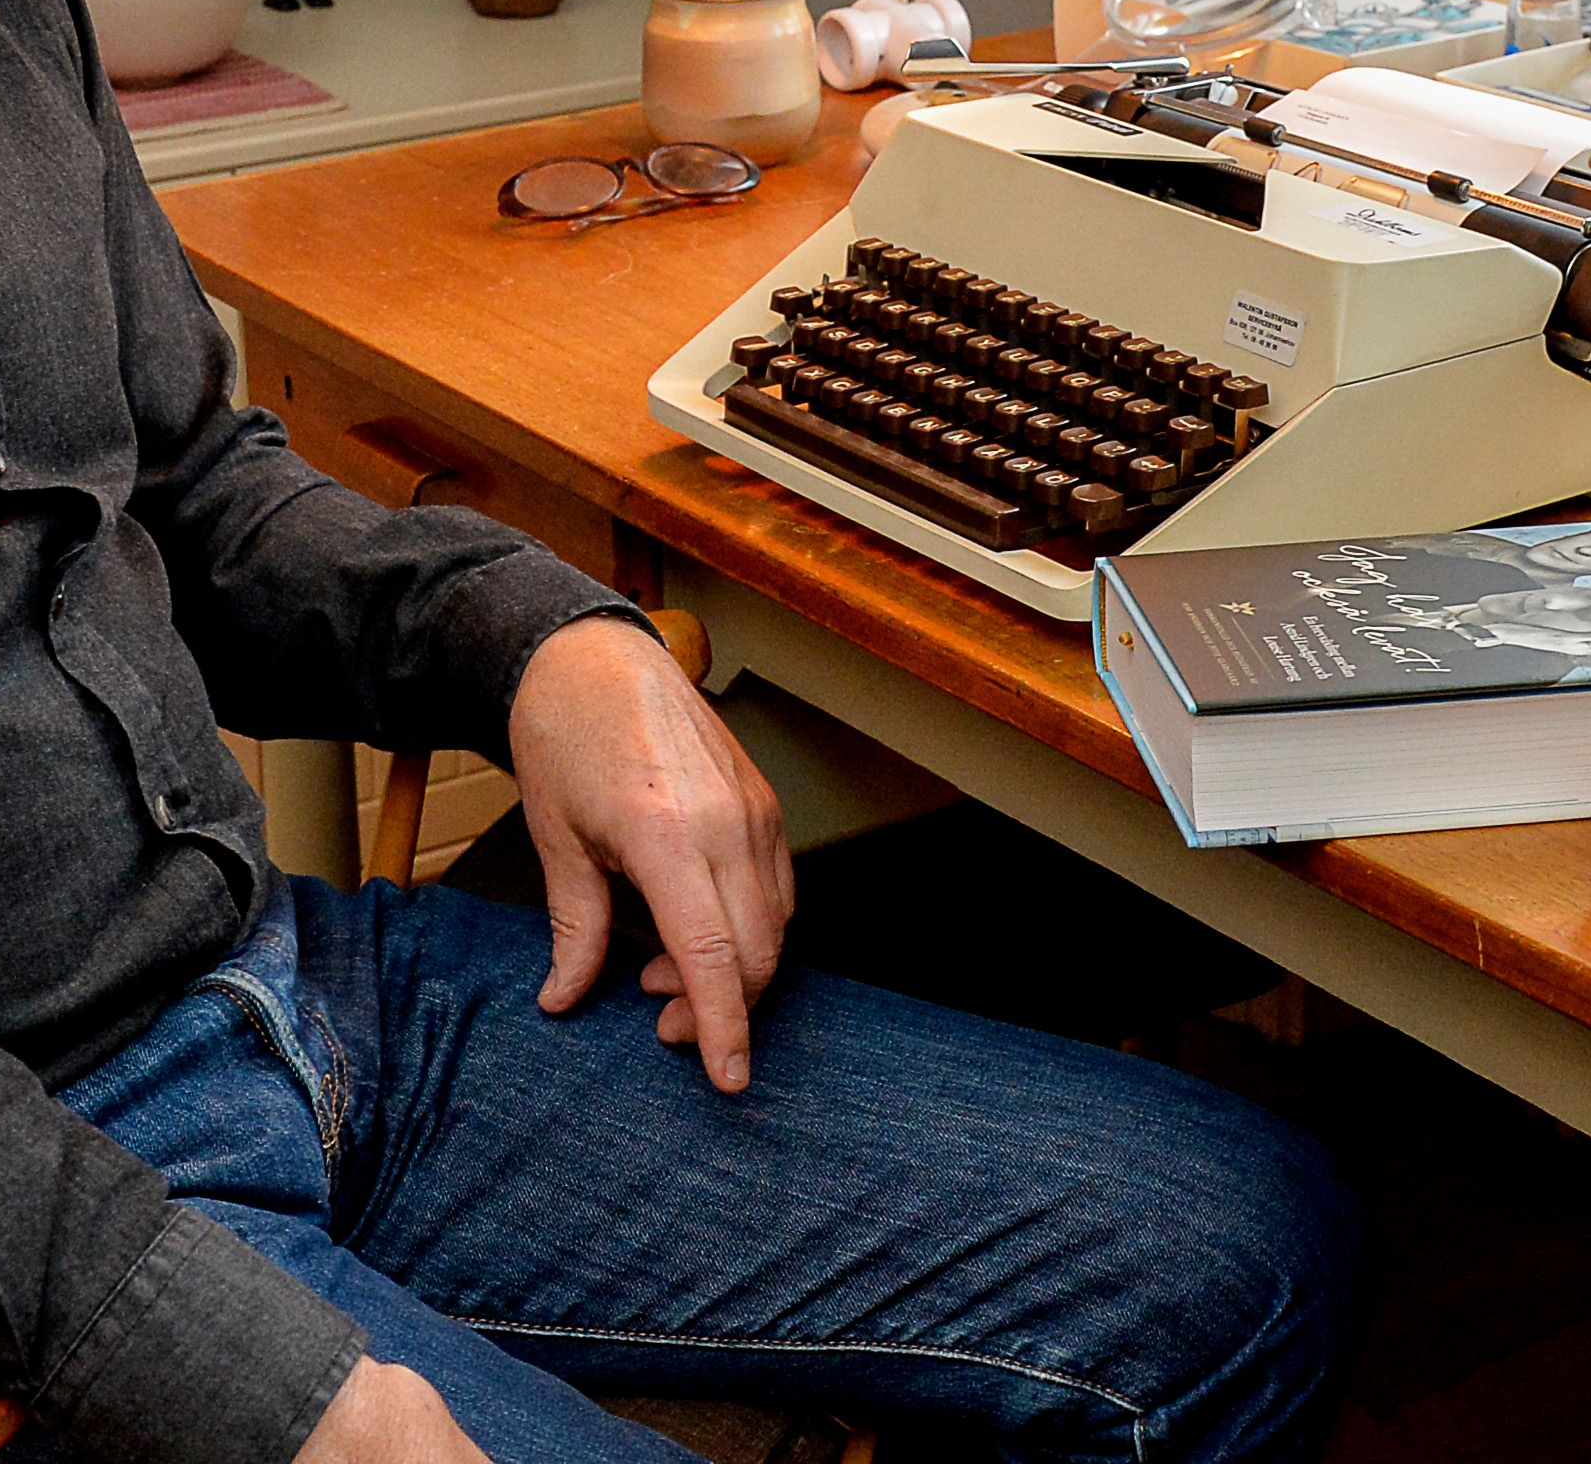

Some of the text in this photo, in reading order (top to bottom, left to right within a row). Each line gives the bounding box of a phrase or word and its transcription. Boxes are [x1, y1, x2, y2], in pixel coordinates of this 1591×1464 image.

[1317, 544, 1407, 588] Jag
[1278, 621, 1307, 640] Astrid
[1291, 570, 1452, 673] också levat!
